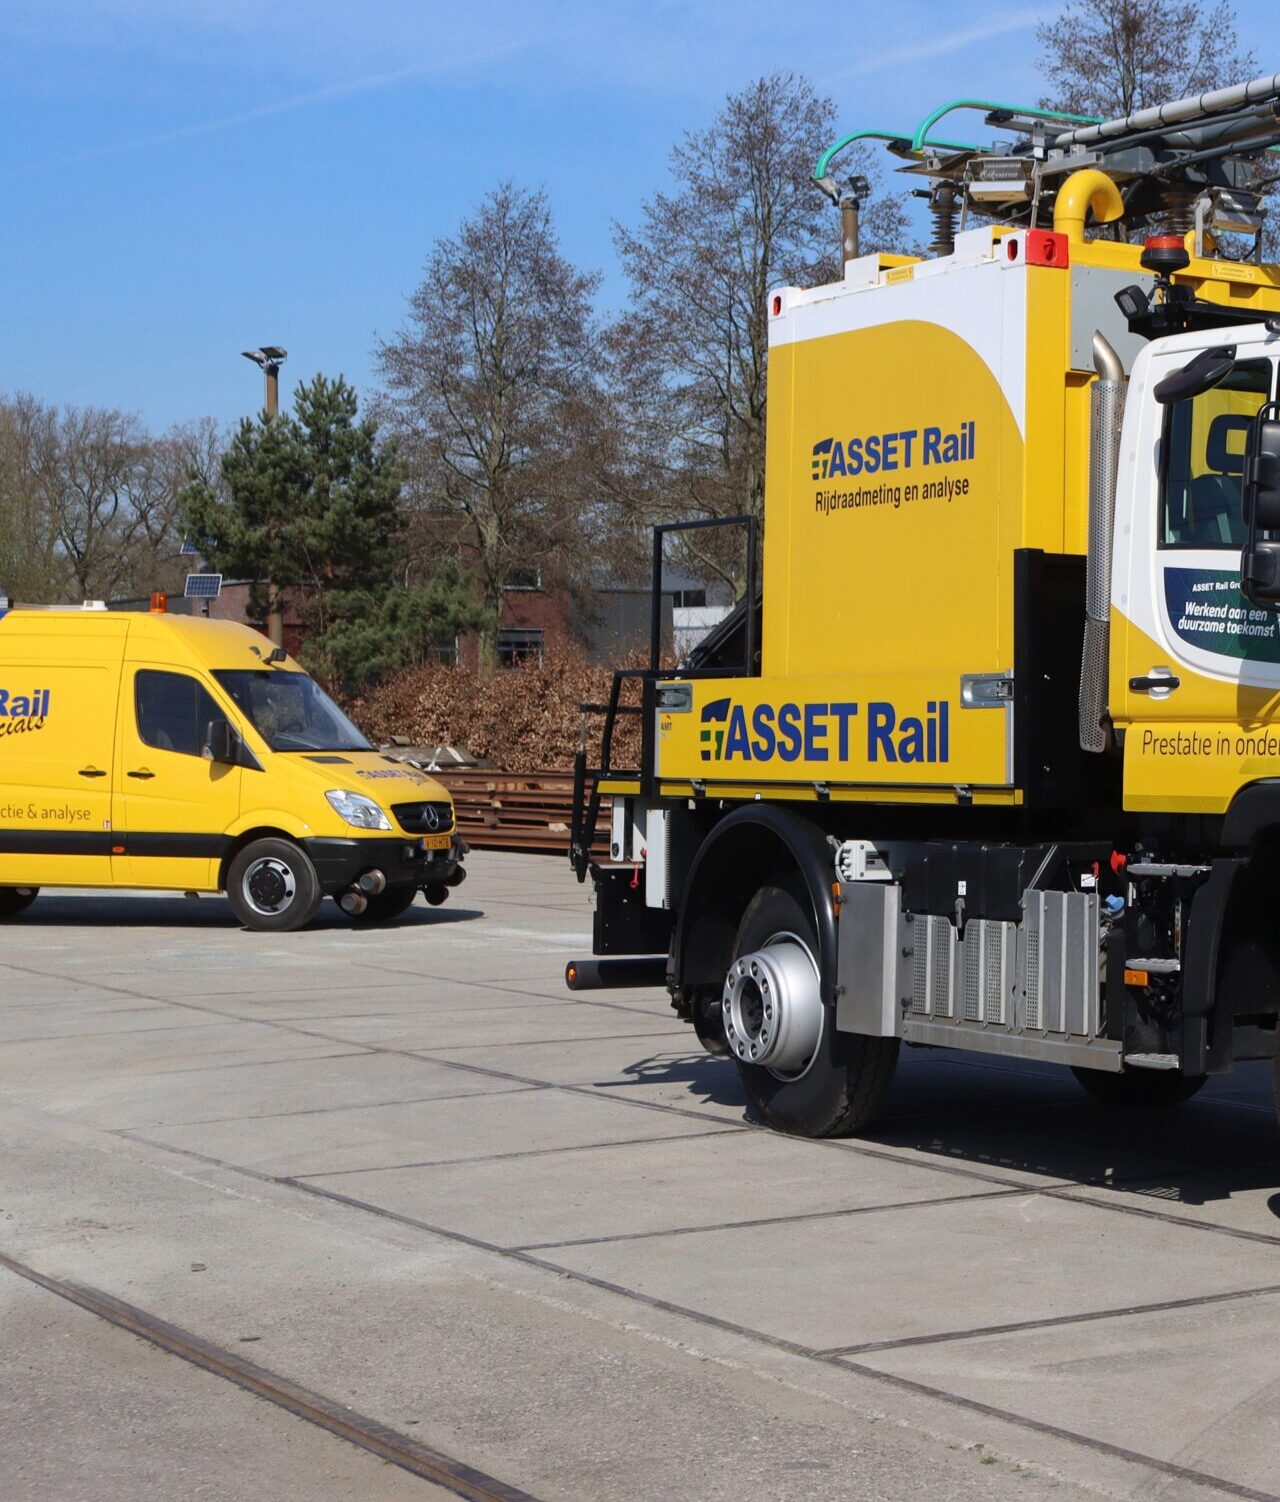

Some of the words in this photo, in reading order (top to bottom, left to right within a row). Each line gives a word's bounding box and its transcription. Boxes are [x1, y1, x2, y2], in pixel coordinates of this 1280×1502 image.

[828, 430, 918, 478] ASSET
[923, 421, 975, 466] Rail
[815, 483, 901, 517] Rijdraadmeting
[904, 484, 919, 502] en
[922, 475, 970, 503] analyse
[1192, 582, 1214, 592] ASSET
[1185, 601, 1228, 618] Werkend
[1228, 608, 1247, 620] aan
[1248, 609, 1268, 621] een
[1178, 616, 1226, 633] duurzame
[1226, 620, 1275, 637] toekomst
[724, 702, 858, 762] ASSET
[867, 701, 949, 763] Rail
[1142, 729, 1212, 756] Prestatie
[1216, 730, 1230, 756] in
[27, 803, 37, 819] &
[41, 804, 91, 824] analyse
